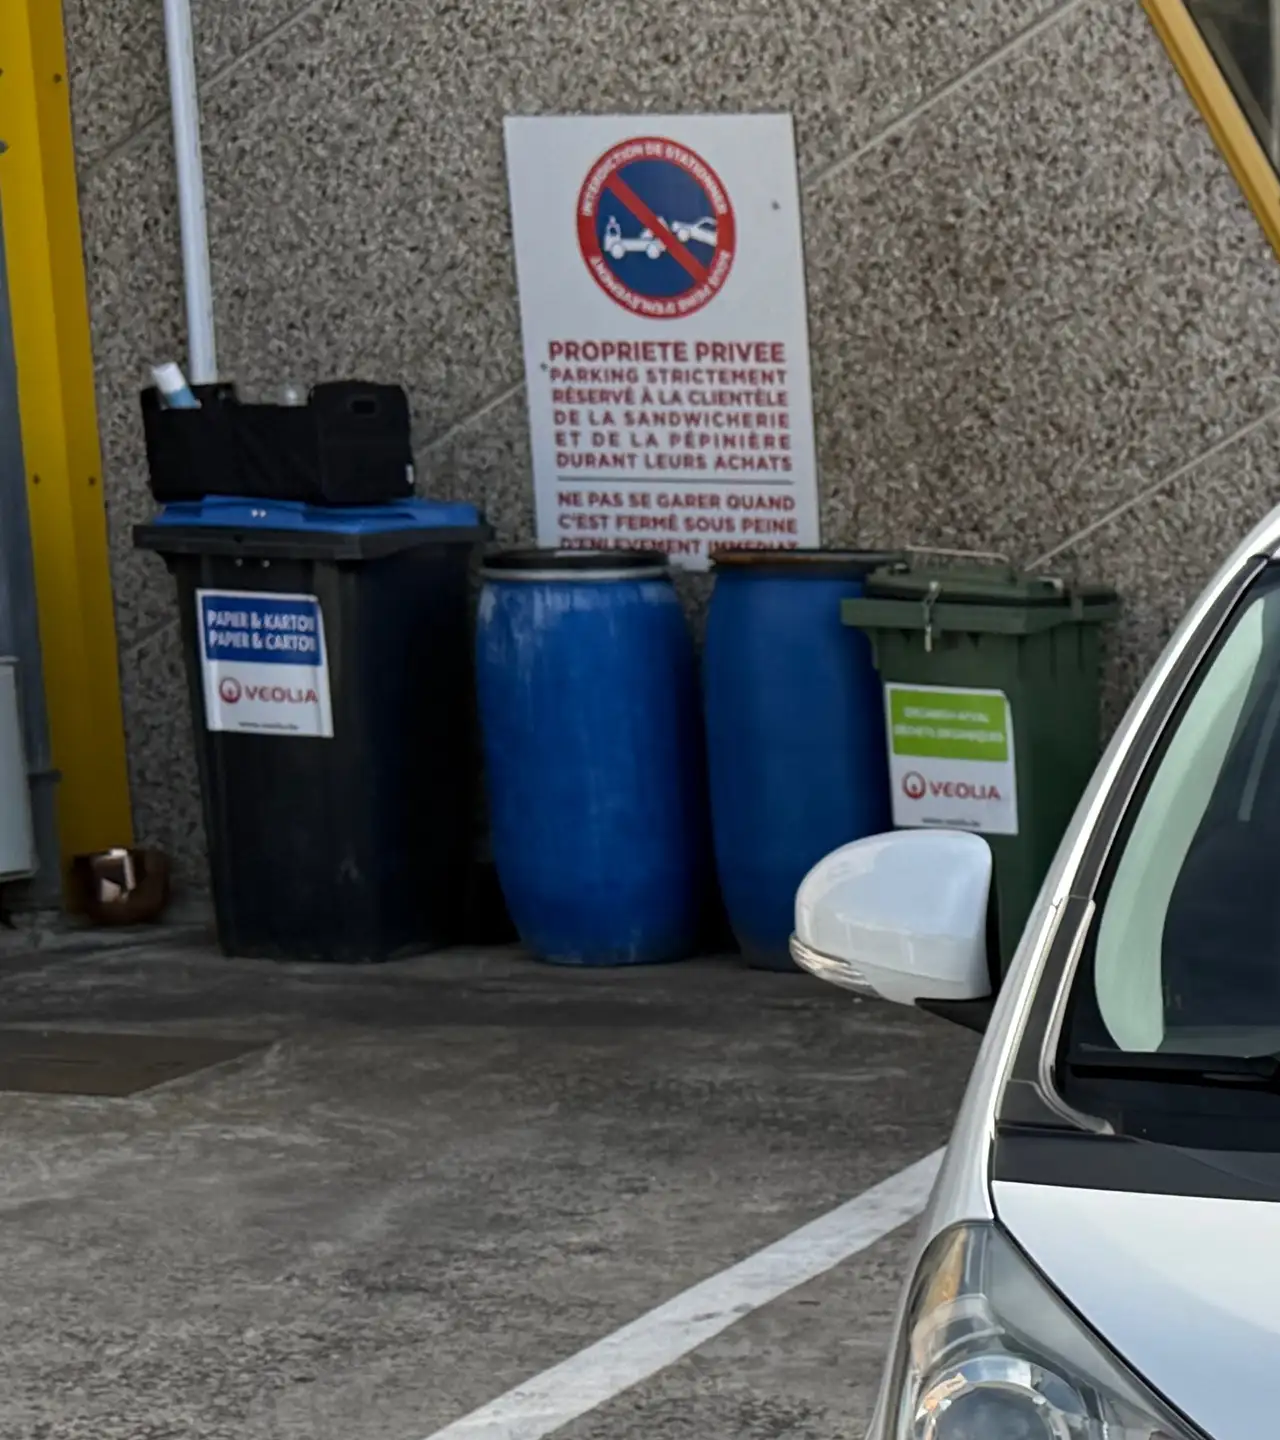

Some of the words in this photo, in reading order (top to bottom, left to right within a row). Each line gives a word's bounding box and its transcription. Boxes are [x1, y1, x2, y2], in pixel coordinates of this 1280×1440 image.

[549, 341, 688, 362] PROPRIETE
[695, 342, 786, 363] PRIVEE
[549, 367, 639, 384] PARKING
[646, 368, 787, 385] STRICTEMENT
[552, 386, 635, 405] RÉSERVÉ
[640, 386, 654, 406] À
[659, 390, 684, 406] LA
[687, 387, 789, 407] CLIENTÈLE
[553, 409, 581, 426] DE
[588, 410, 615, 426] LA
[624, 411, 790, 428] SANDWICHERIE
[554, 431, 581, 447] ET
[592, 431, 620, 448] DE
[631, 432, 659, 448] LA
[669, 430, 791, 450] PÉPINIÈRE
[556, 453, 638, 469] DURANT
[644, 453, 707, 470] LEURS
[714, 455, 792, 472] ACHATS
[557, 491, 583, 507] NE
[588, 492, 623, 508] PAS
[628, 492, 650, 508] SE
[656, 493, 721, 510] GARER
[726, 494, 796, 511] QUAND
[558, 513, 611, 530] C'EST
[616, 513, 679, 532] FERMÉ
[684, 516, 736, 532] SOUS
[742, 517, 798, 534] PEINE
[207, 610, 249, 628] PAPIER
[208, 629, 250, 648] PAPIER
[244, 684, 317, 705] VEOLIA
[930, 781, 1002, 800] VEOLIA
